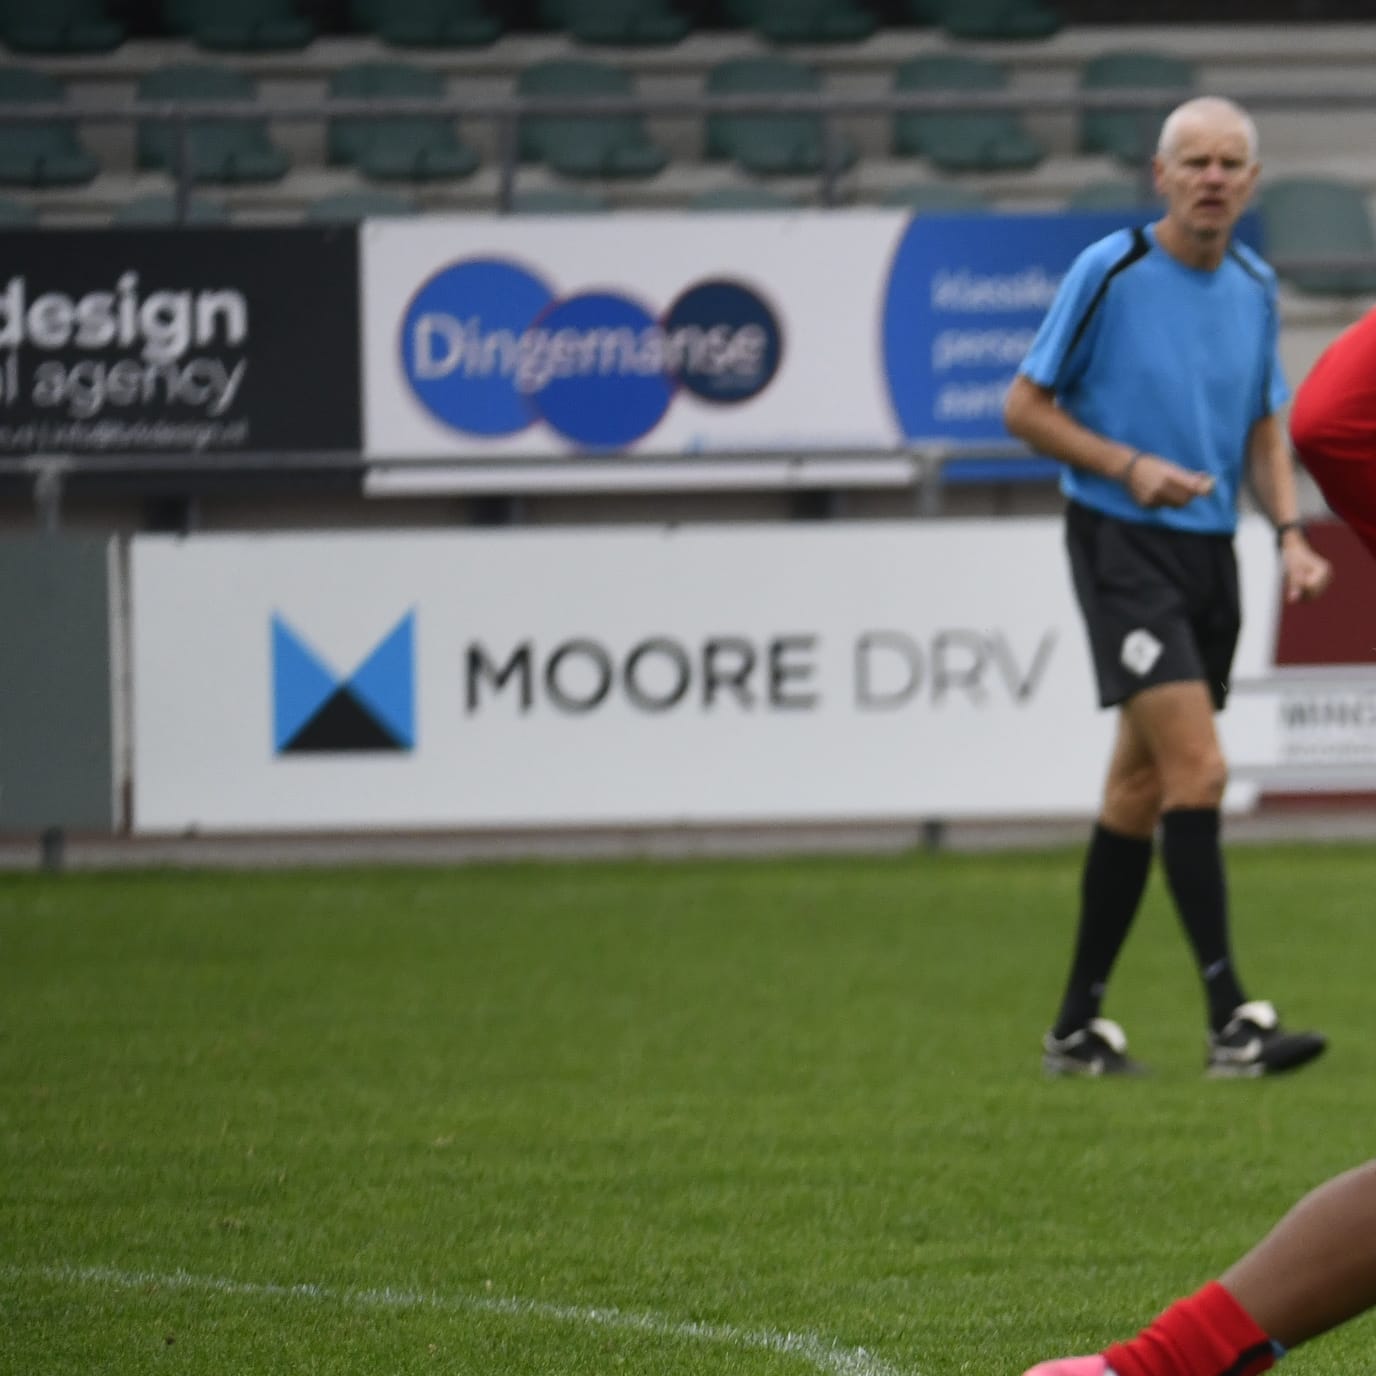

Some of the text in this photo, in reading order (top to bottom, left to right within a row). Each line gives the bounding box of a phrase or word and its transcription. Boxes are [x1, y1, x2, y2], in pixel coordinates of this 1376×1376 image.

[413, 312, 770, 393] Dingemanse
[464, 627, 1058, 715] MOORE DRV
